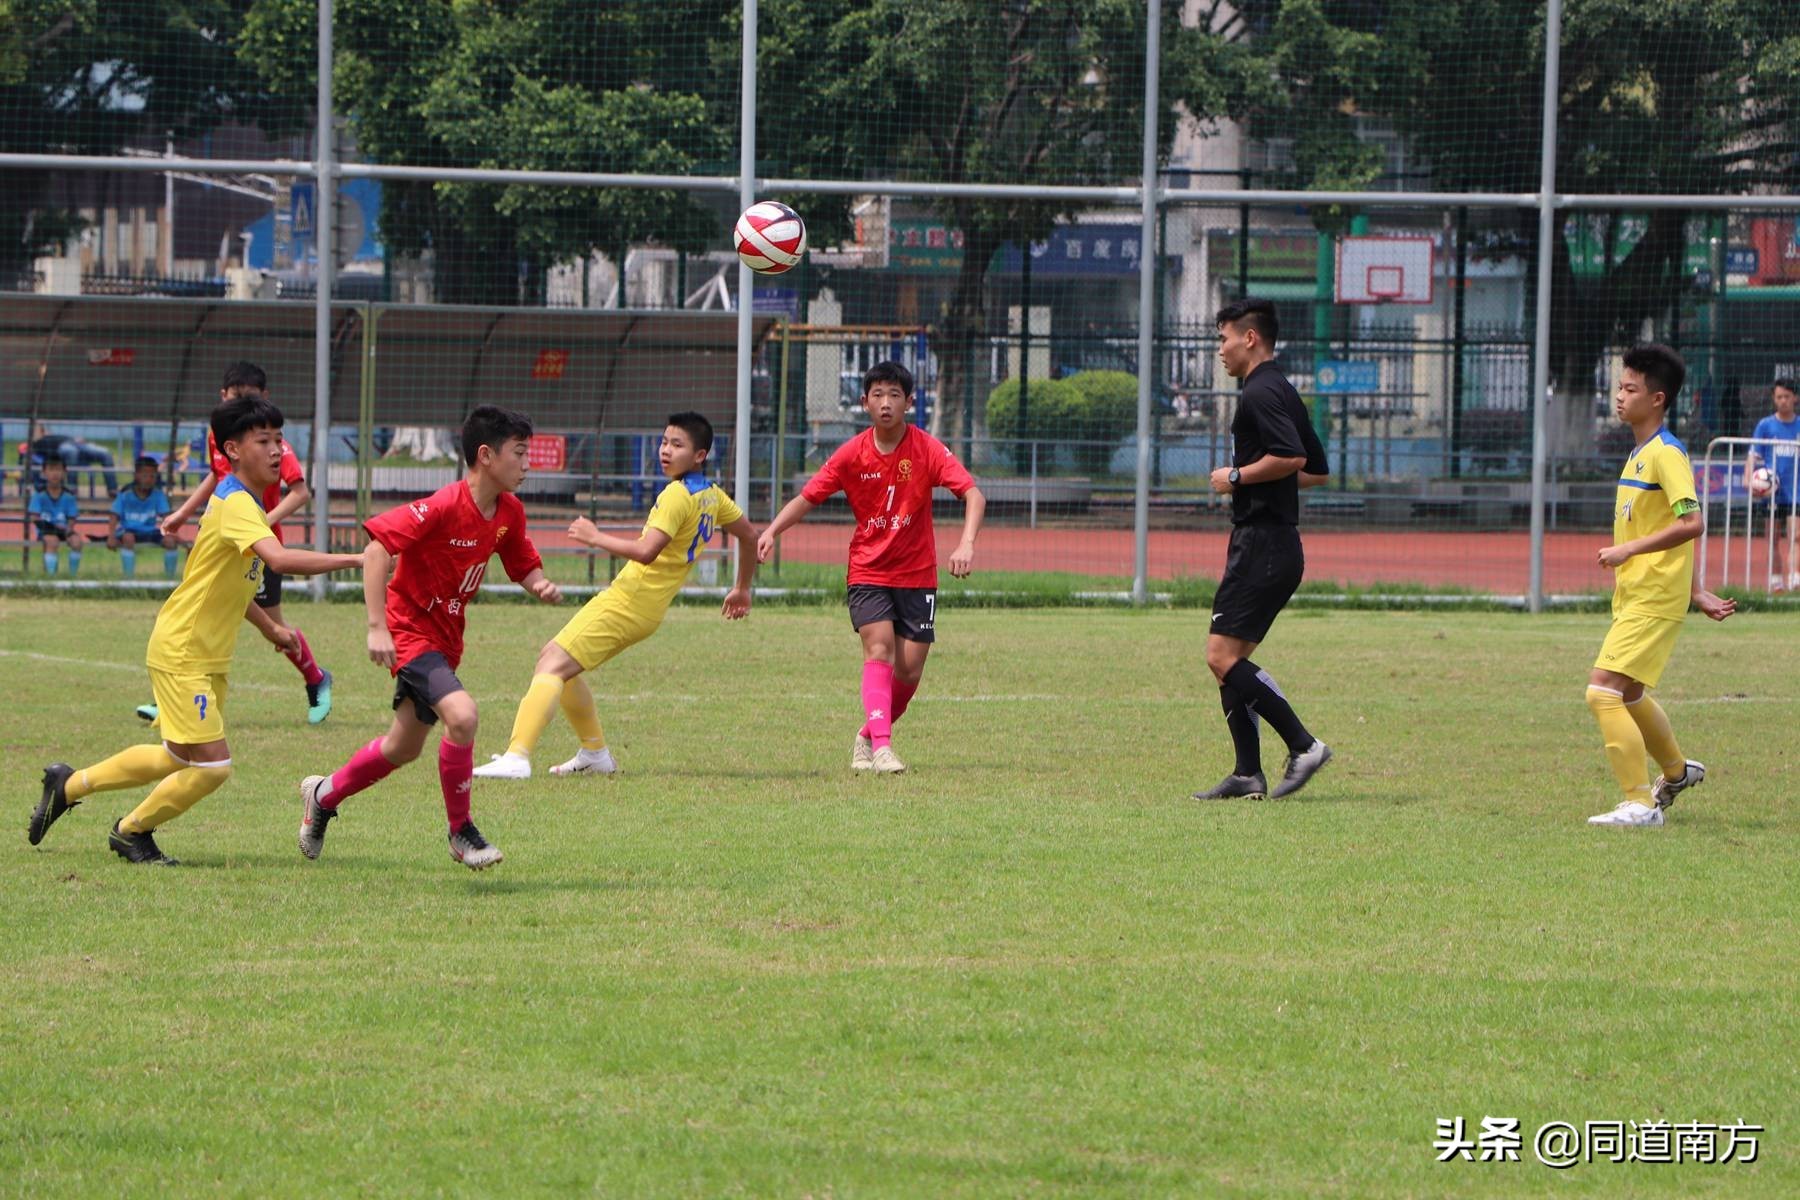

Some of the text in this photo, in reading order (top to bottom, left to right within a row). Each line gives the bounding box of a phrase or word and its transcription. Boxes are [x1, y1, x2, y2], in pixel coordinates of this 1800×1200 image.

[886, 485, 896, 512] 7
[449, 538, 478, 547] KELME
[459, 561, 486, 593] 10
[925, 594, 935, 621] 7
